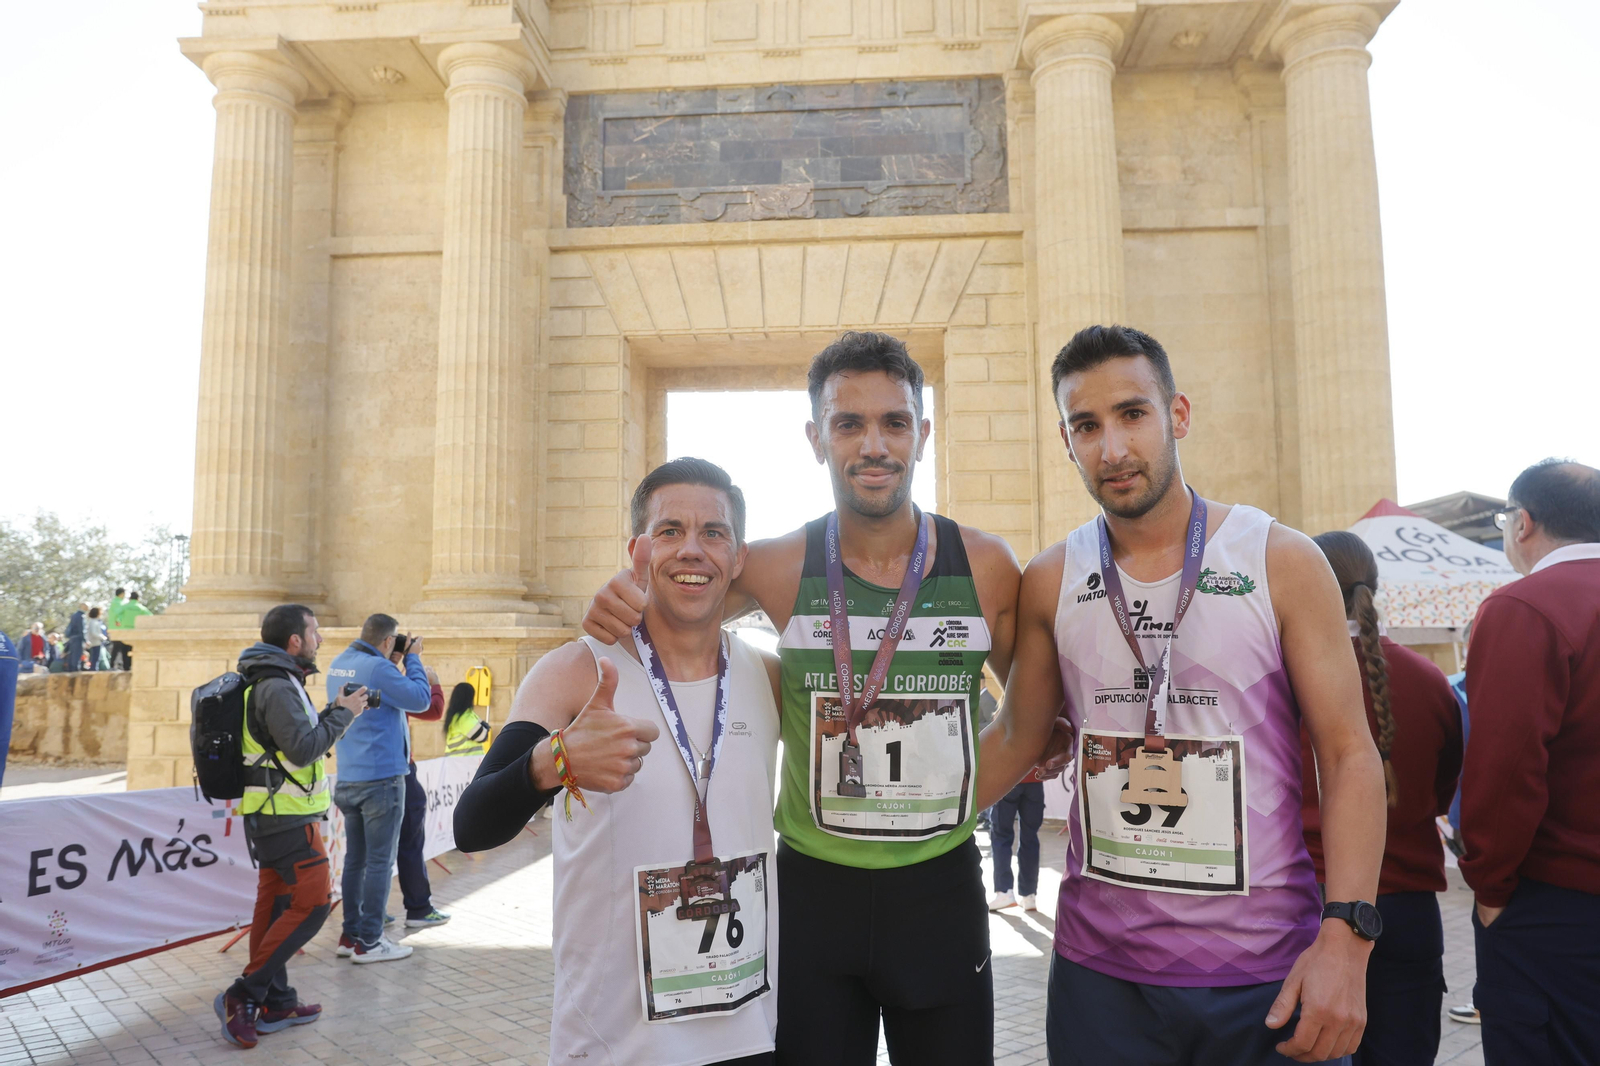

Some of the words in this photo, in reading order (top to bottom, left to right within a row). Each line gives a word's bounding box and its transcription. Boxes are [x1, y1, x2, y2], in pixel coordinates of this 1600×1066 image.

[833, 590, 842, 615] MEDIA
[932, 600, 947, 609] LSC
[1178, 587, 1190, 614] MEDIA
[812, 630, 832, 638] CÓRD
[862, 685, 877, 710] MEDIA
[913, 551, 924, 574] MEDIA
[947, 640, 967, 648] CAC
[894, 670, 973, 691] CORDOBÉS
[1095, 692, 1148, 705] DIPUTACIÓN
[1167, 695, 1218, 706] ALBACETE
[886, 741, 901, 782] 1
[1135, 847, 1166, 857] CAJÓN
[27, 843, 88, 897] ES
[655, 880, 680, 889] MARATÓN
[677, 903, 739, 918] CÓRDOBA
[692, 911, 744, 955] 76
